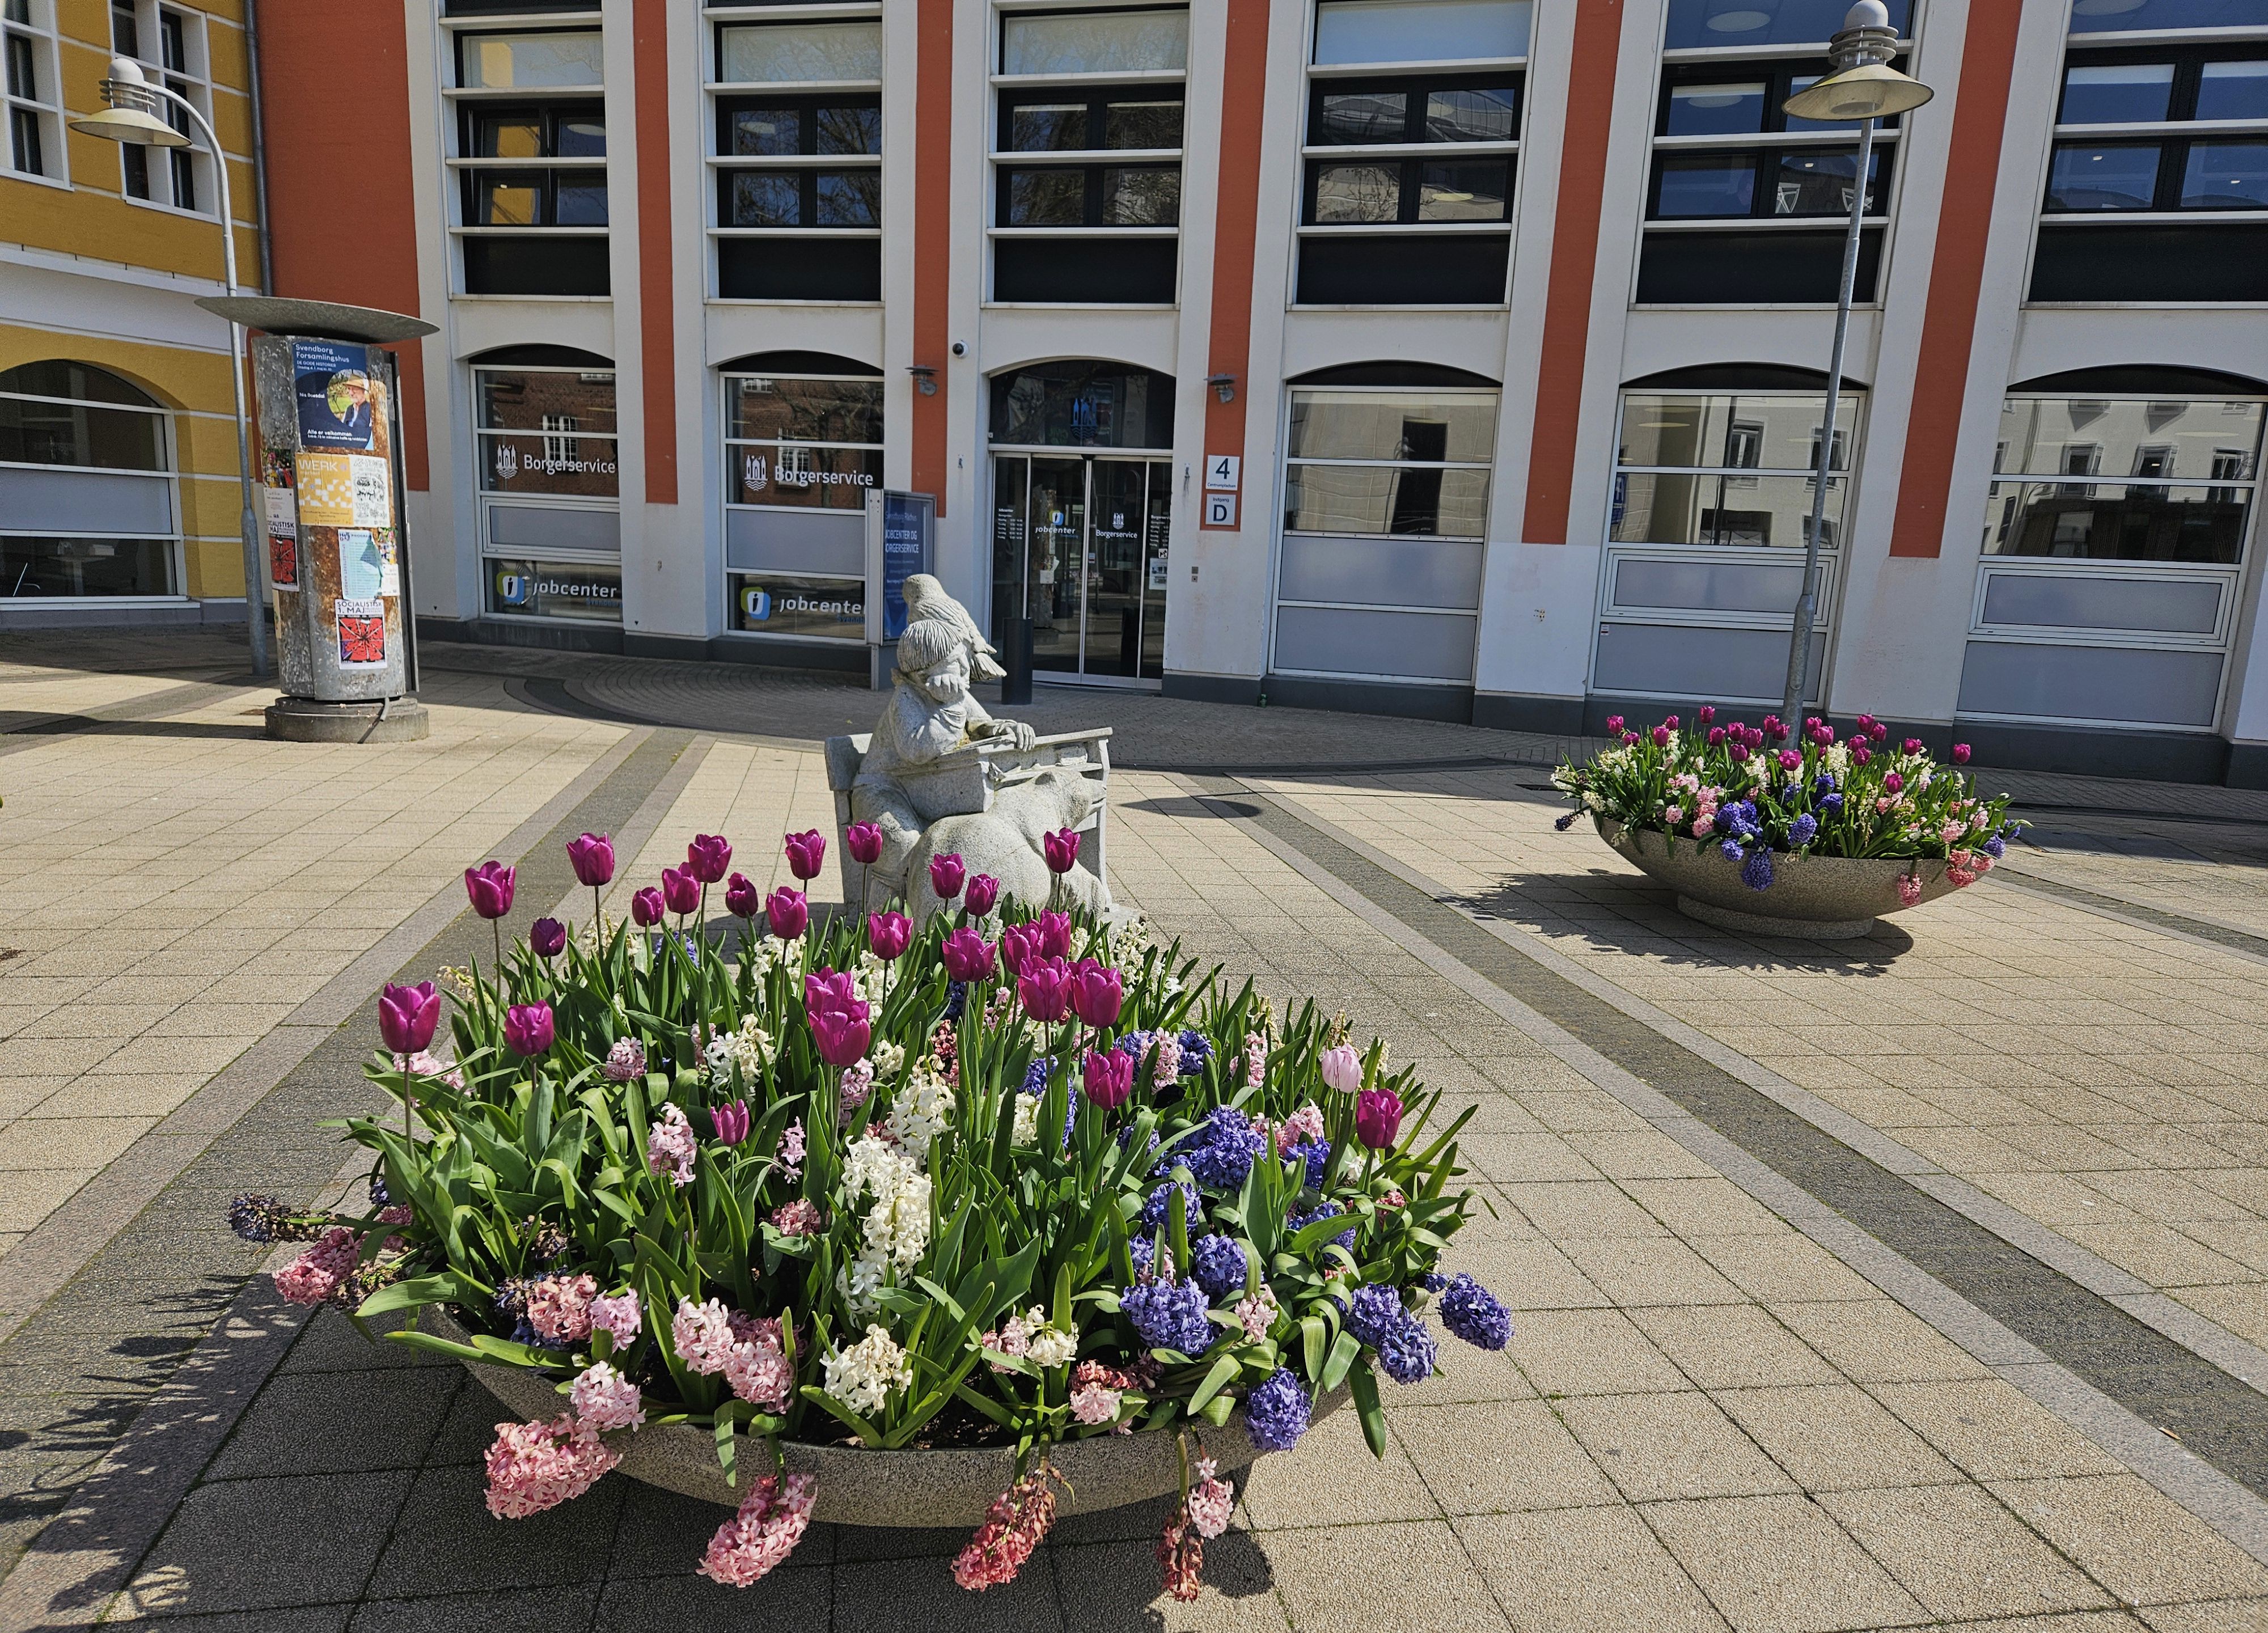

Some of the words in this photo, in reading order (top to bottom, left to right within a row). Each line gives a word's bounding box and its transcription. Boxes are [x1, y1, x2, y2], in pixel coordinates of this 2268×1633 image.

[295, 344, 333, 354] Svendborg
[296, 352, 349, 362] Forsamlingshus
[298, 459, 338, 472] WERK
[524, 454, 615, 475] Borgerservice
[1216, 458, 1230, 479] 4
[775, 465, 873, 486] Borgerservice
[1213, 504, 1227, 522] D
[885, 530, 910, 539] JOBCENTER
[910, 531, 917, 540] OG
[1035, 526, 1076, 534] jobcenter
[1095, 530, 1137, 539] Borgerservice
[533, 579, 617, 598] jobcenter
[780, 595, 866, 614] jobcente
